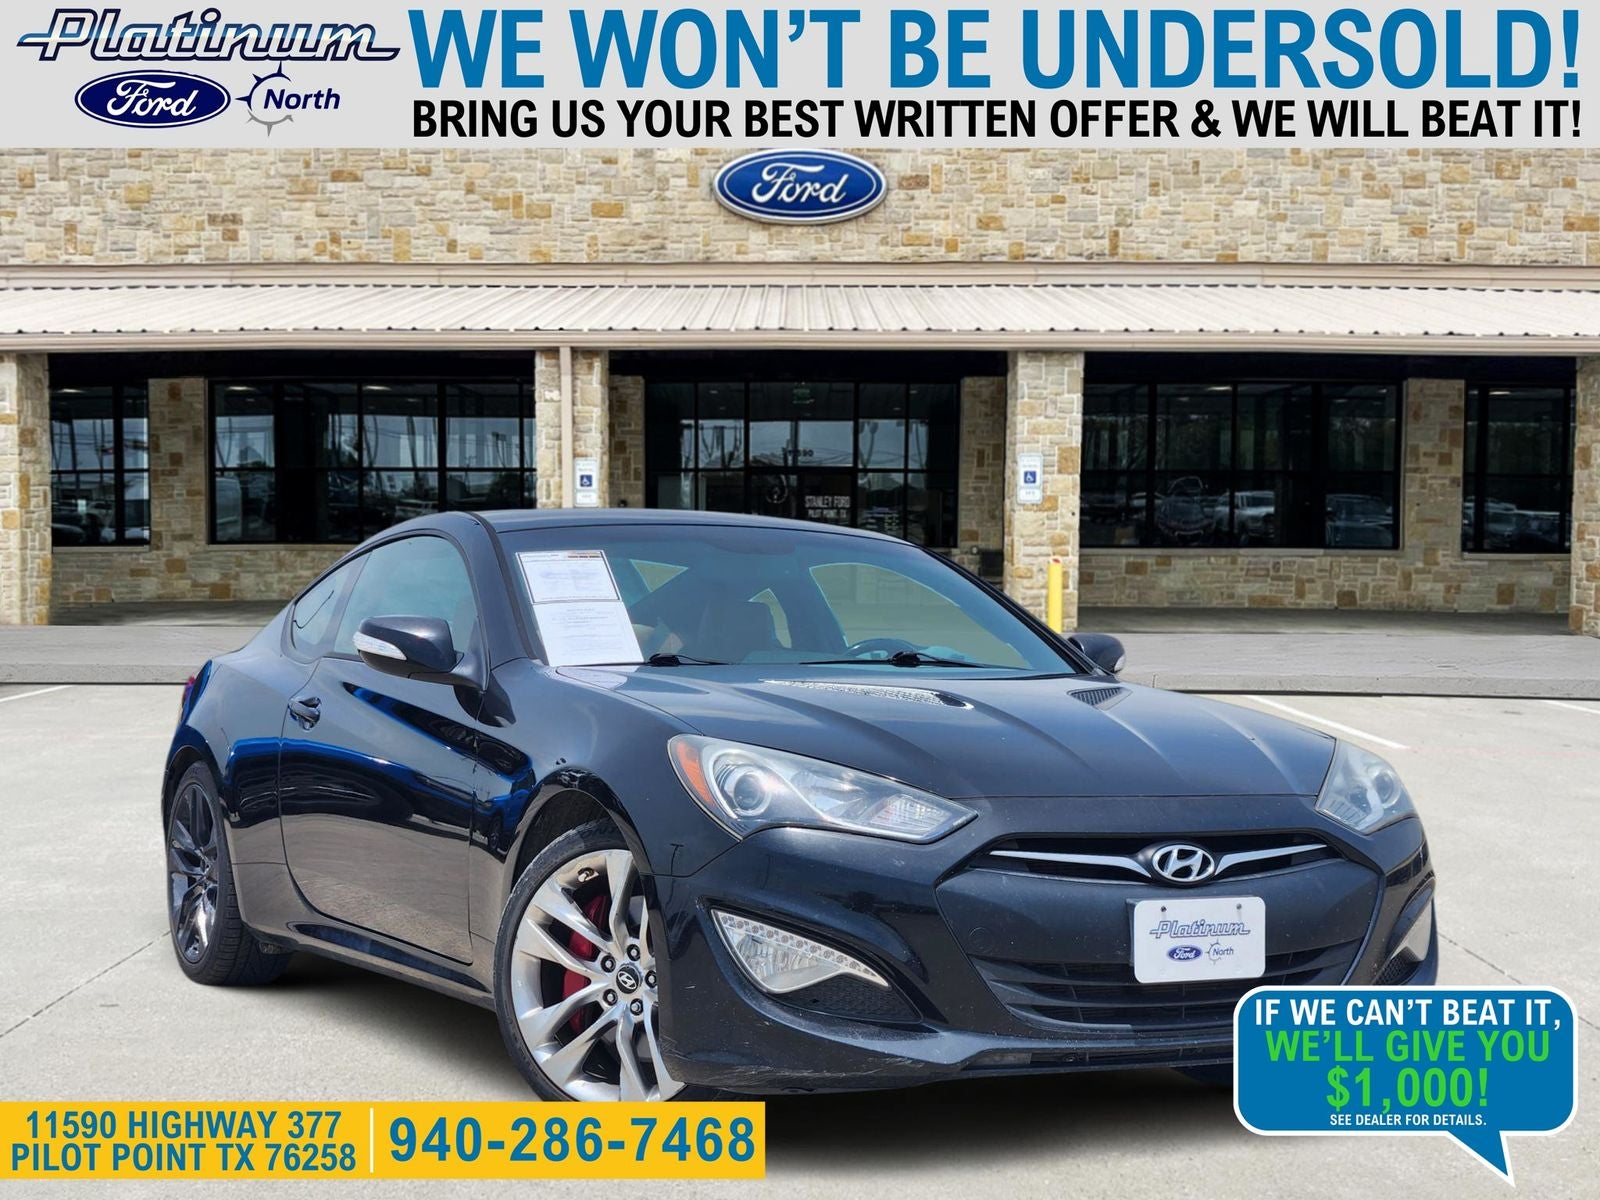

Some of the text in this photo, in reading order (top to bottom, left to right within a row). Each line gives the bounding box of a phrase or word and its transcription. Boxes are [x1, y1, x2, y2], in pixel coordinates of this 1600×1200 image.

[751, 161, 849, 204] Ford
[1149, 919, 1251, 939] Platinum
[1173, 946, 1196, 960] Ford
[1213, 946, 1234, 956] North
